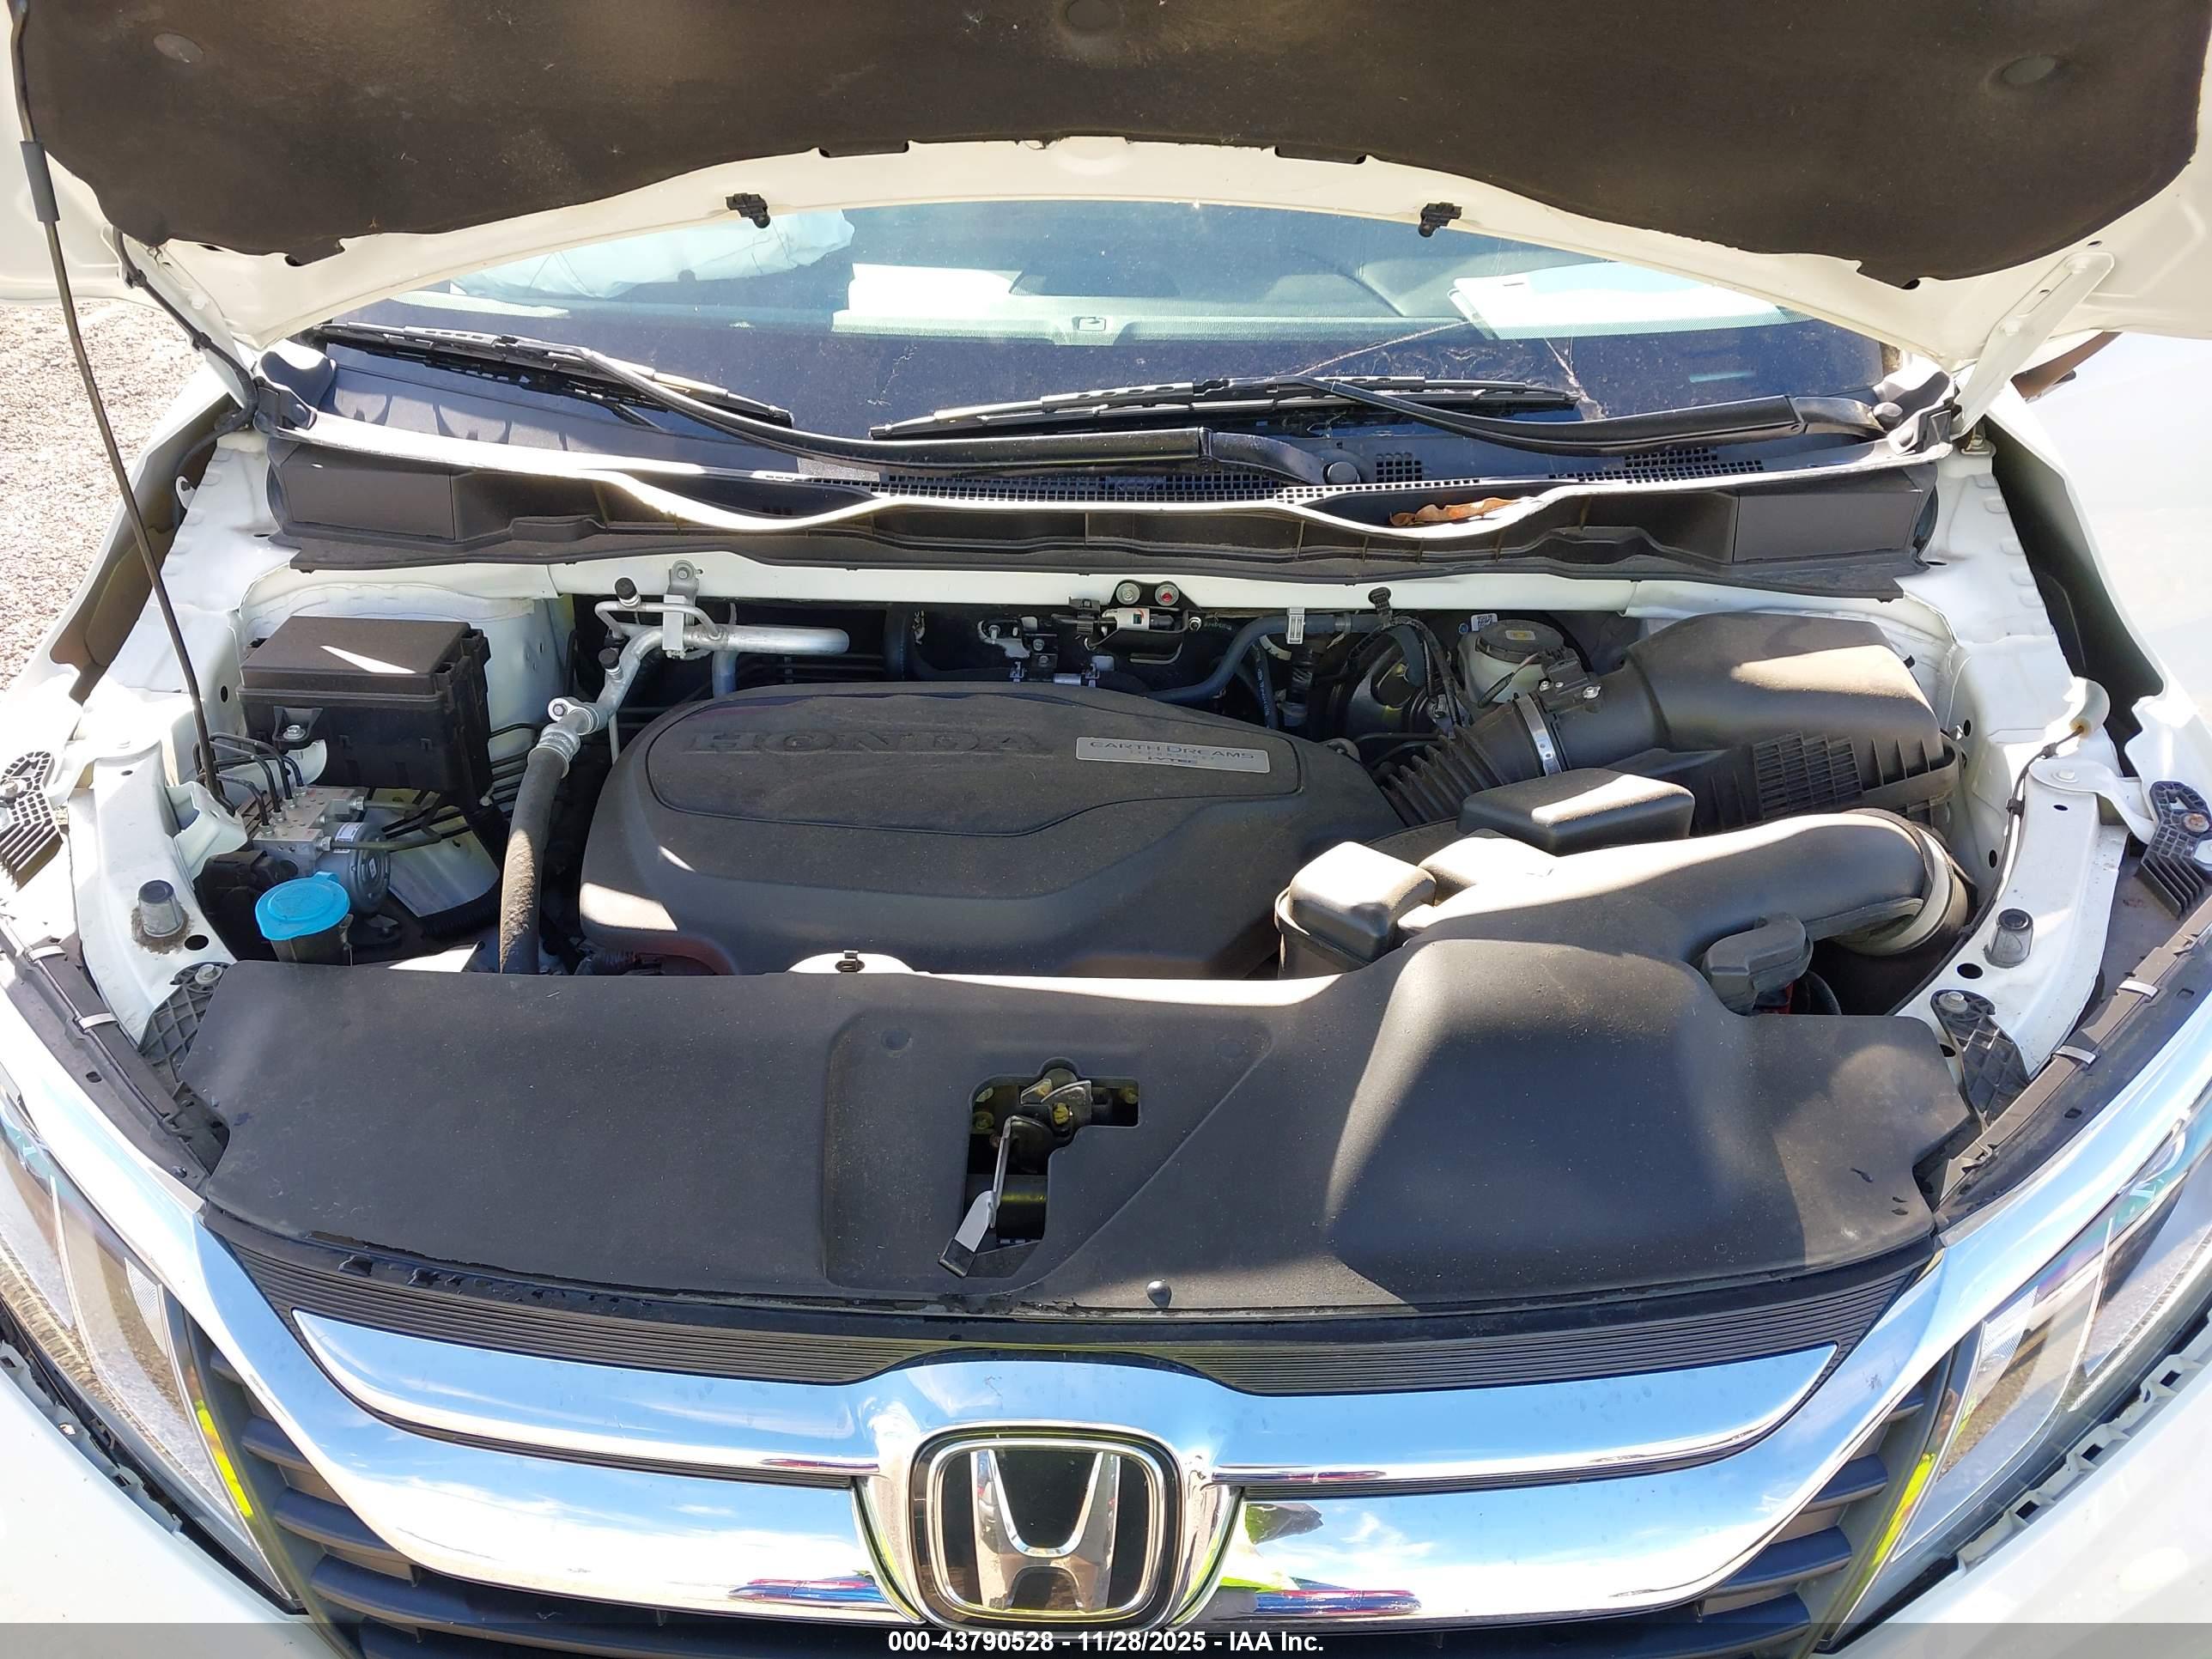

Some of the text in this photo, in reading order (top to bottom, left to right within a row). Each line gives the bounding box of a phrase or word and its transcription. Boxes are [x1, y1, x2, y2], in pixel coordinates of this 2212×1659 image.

[684, 730, 1054, 757] HONDA
[1090, 740, 1161, 752] EARTH
[1166, 744, 1255, 760] DREAMS
